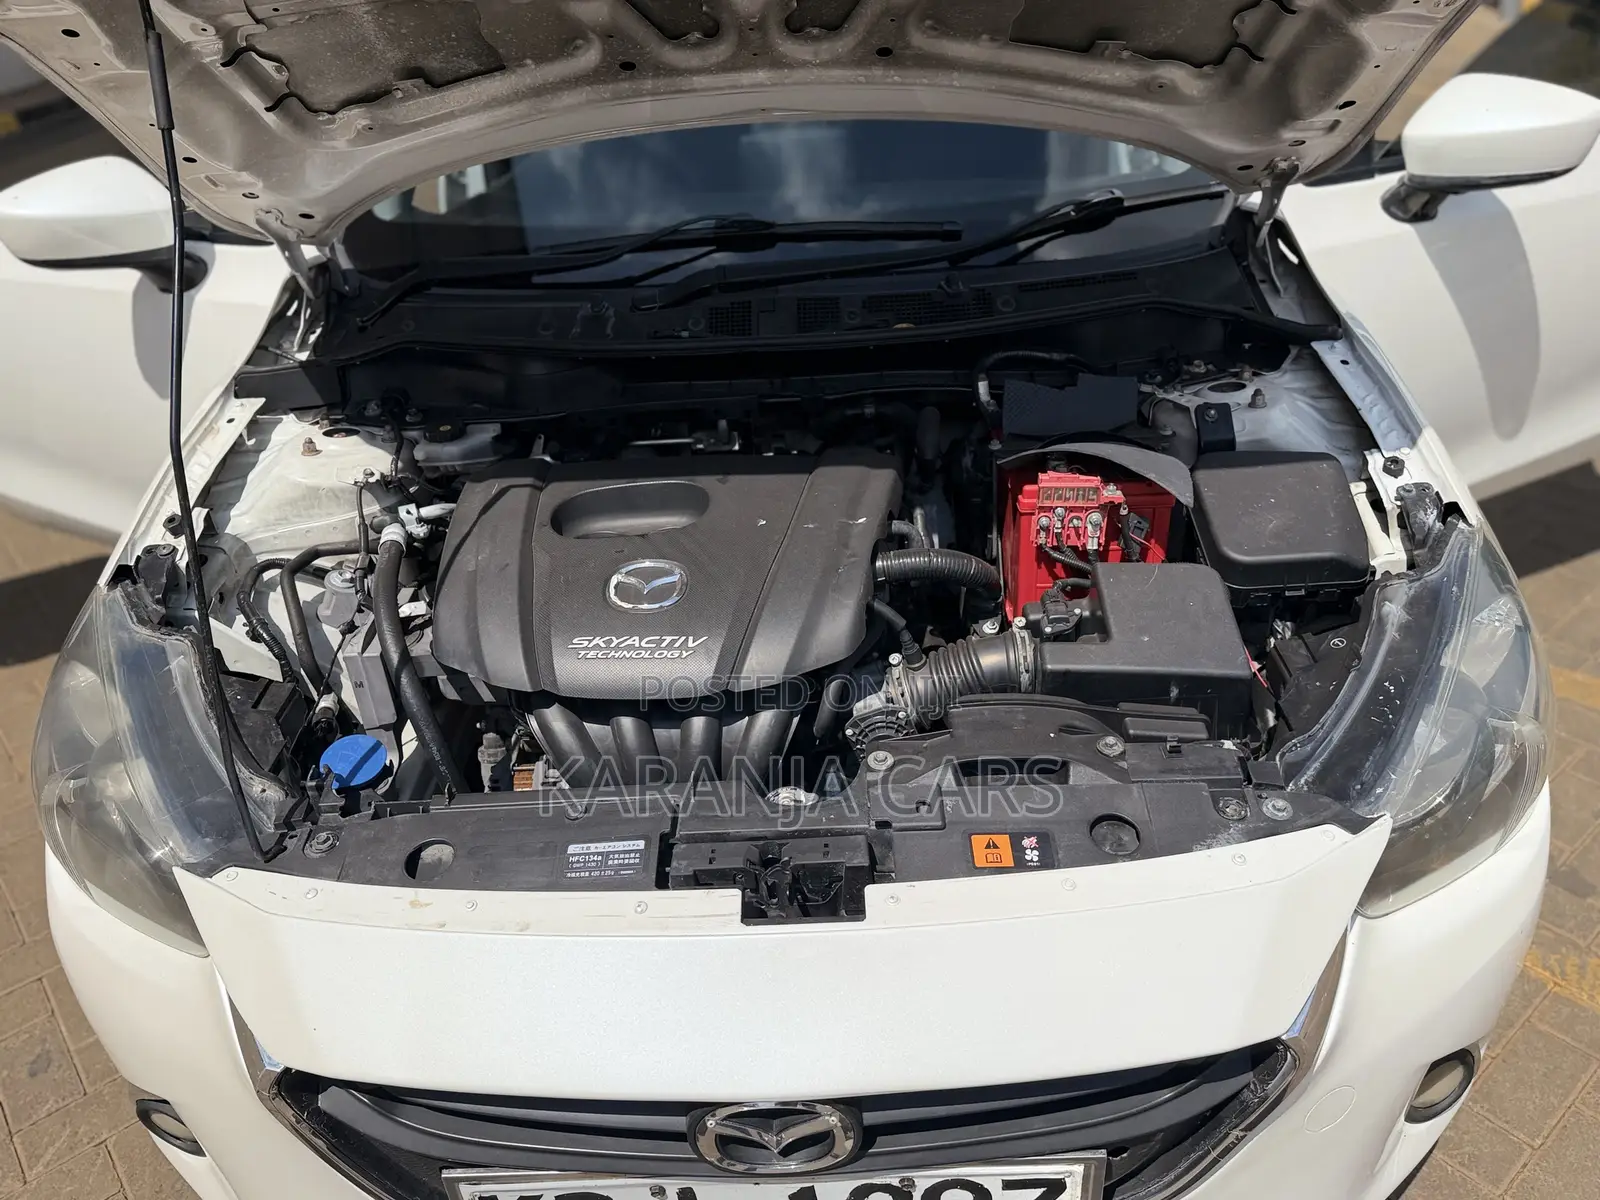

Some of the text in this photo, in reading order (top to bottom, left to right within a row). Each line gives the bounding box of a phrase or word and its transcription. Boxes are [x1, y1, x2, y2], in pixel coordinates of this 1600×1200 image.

[568, 636, 709, 648] SKYACTIV
[577, 650, 695, 659] TECHNOLOGY
[353, 680, 365, 689] M
[568, 854, 602, 863] HFC134a
